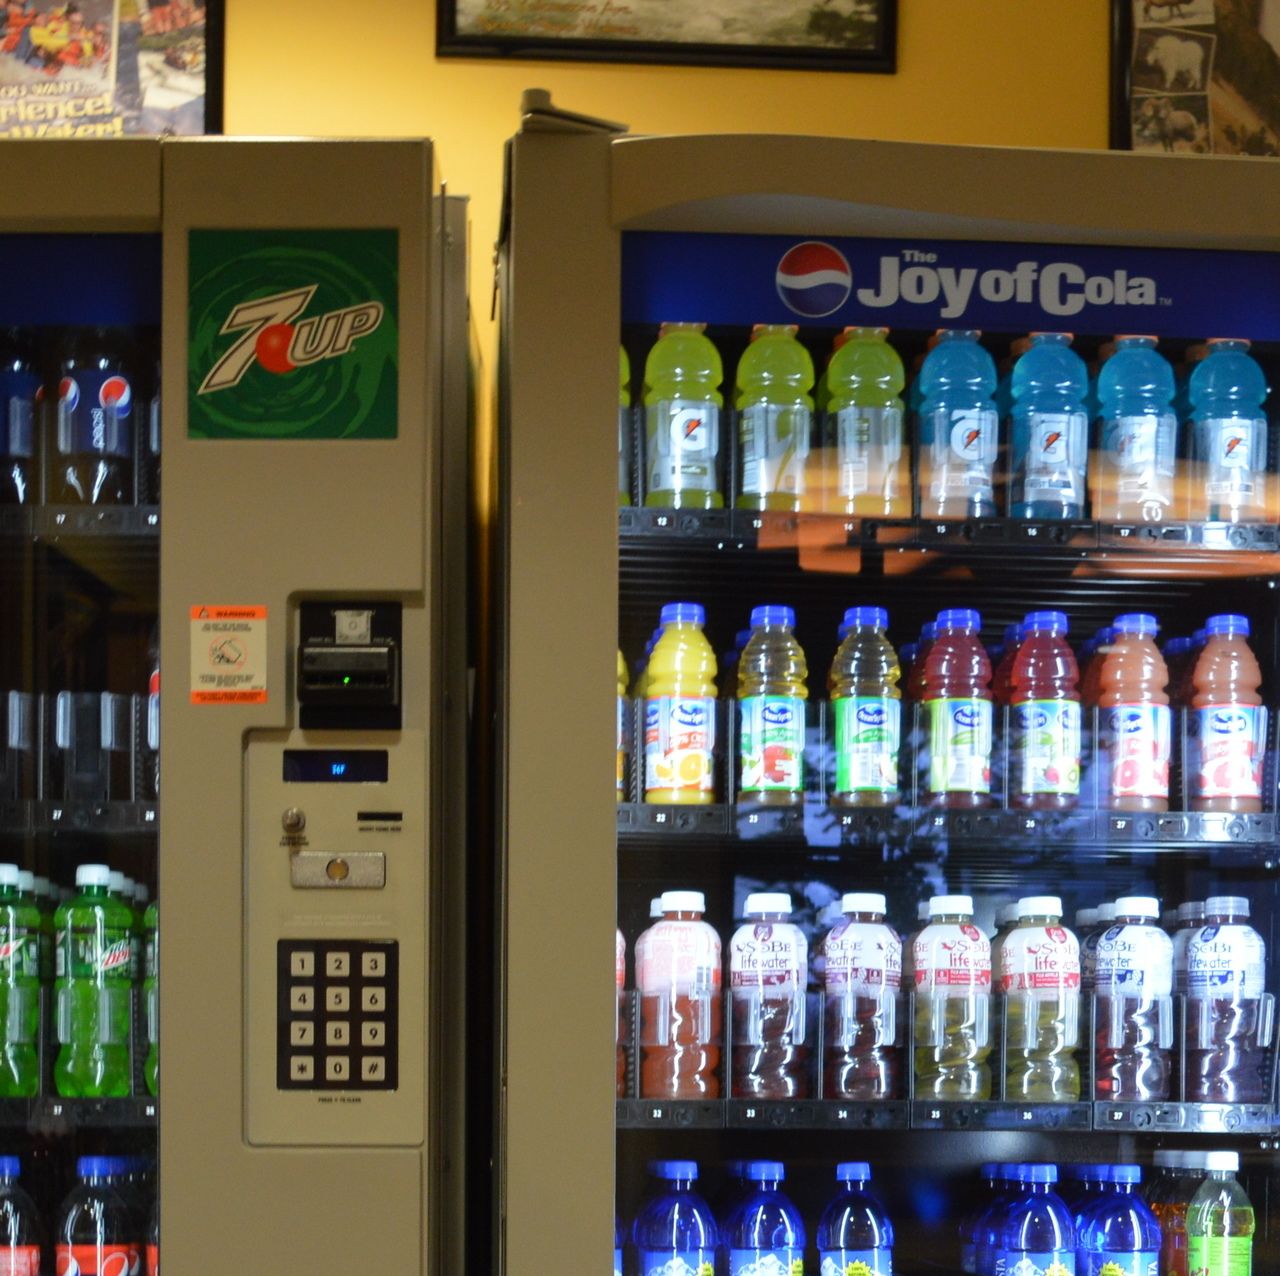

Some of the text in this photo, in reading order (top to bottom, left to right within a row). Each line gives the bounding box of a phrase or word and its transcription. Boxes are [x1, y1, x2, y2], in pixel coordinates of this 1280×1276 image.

[900, 249, 937, 264] The
[300, 958, 378, 970] 1 2 3
[298, 993, 378, 1005] 4 5 6
[300, 1028, 378, 1039] 7 8 9
[333, 1063, 343, 1074] 0
